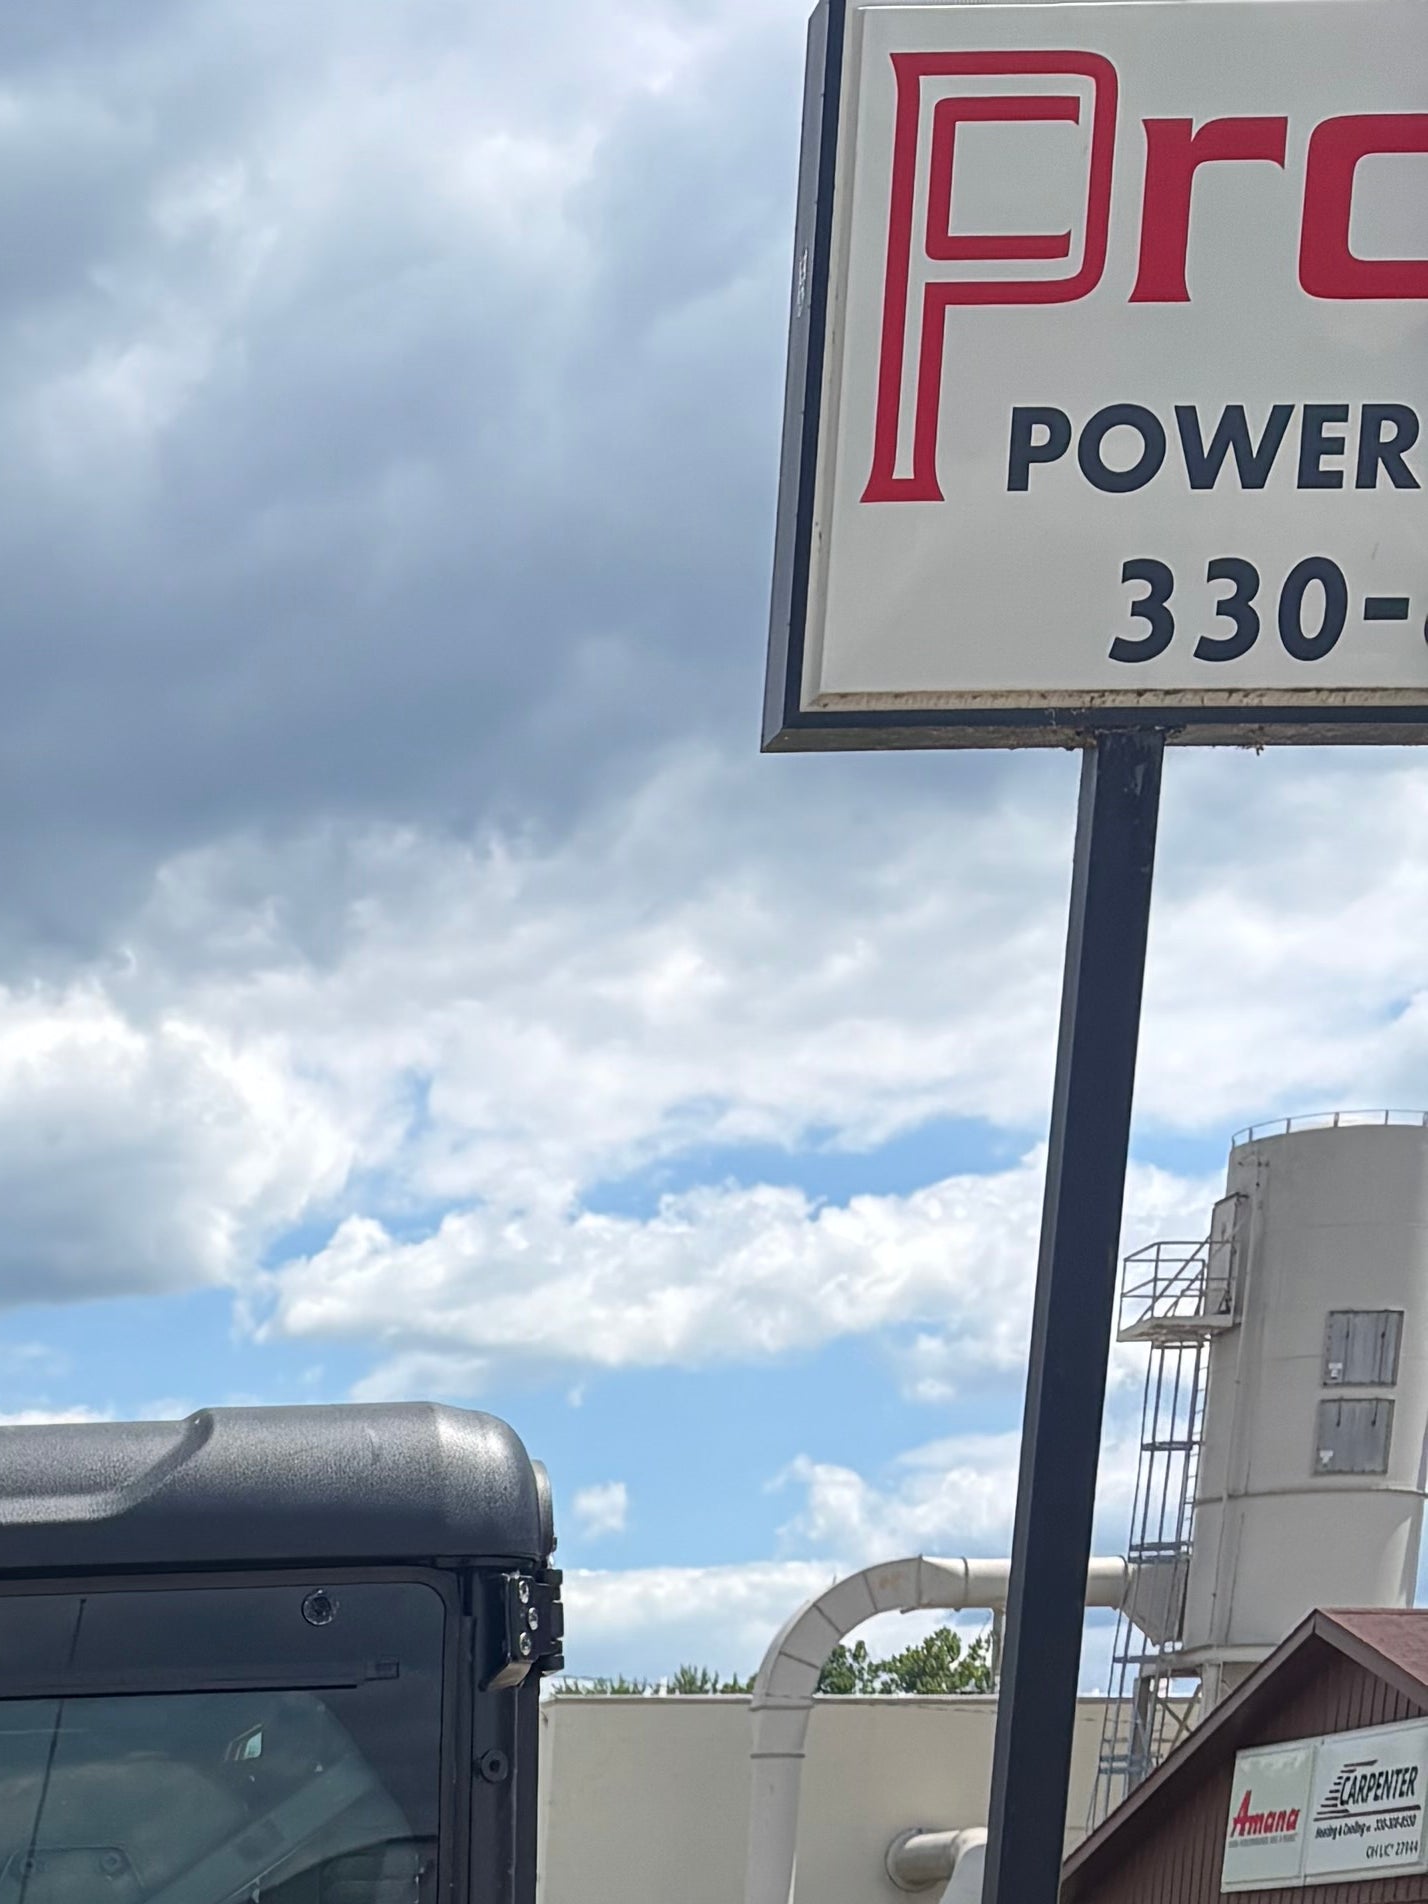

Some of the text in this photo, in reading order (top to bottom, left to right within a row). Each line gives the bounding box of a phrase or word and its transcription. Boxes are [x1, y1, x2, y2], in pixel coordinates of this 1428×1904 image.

[1007, 403, 1421, 493] POWER
[1108, 557, 1428, 663] 330-
[1230, 1789, 1300, 1838] Amana
[1339, 1766, 1418, 1806] CARPENTER
